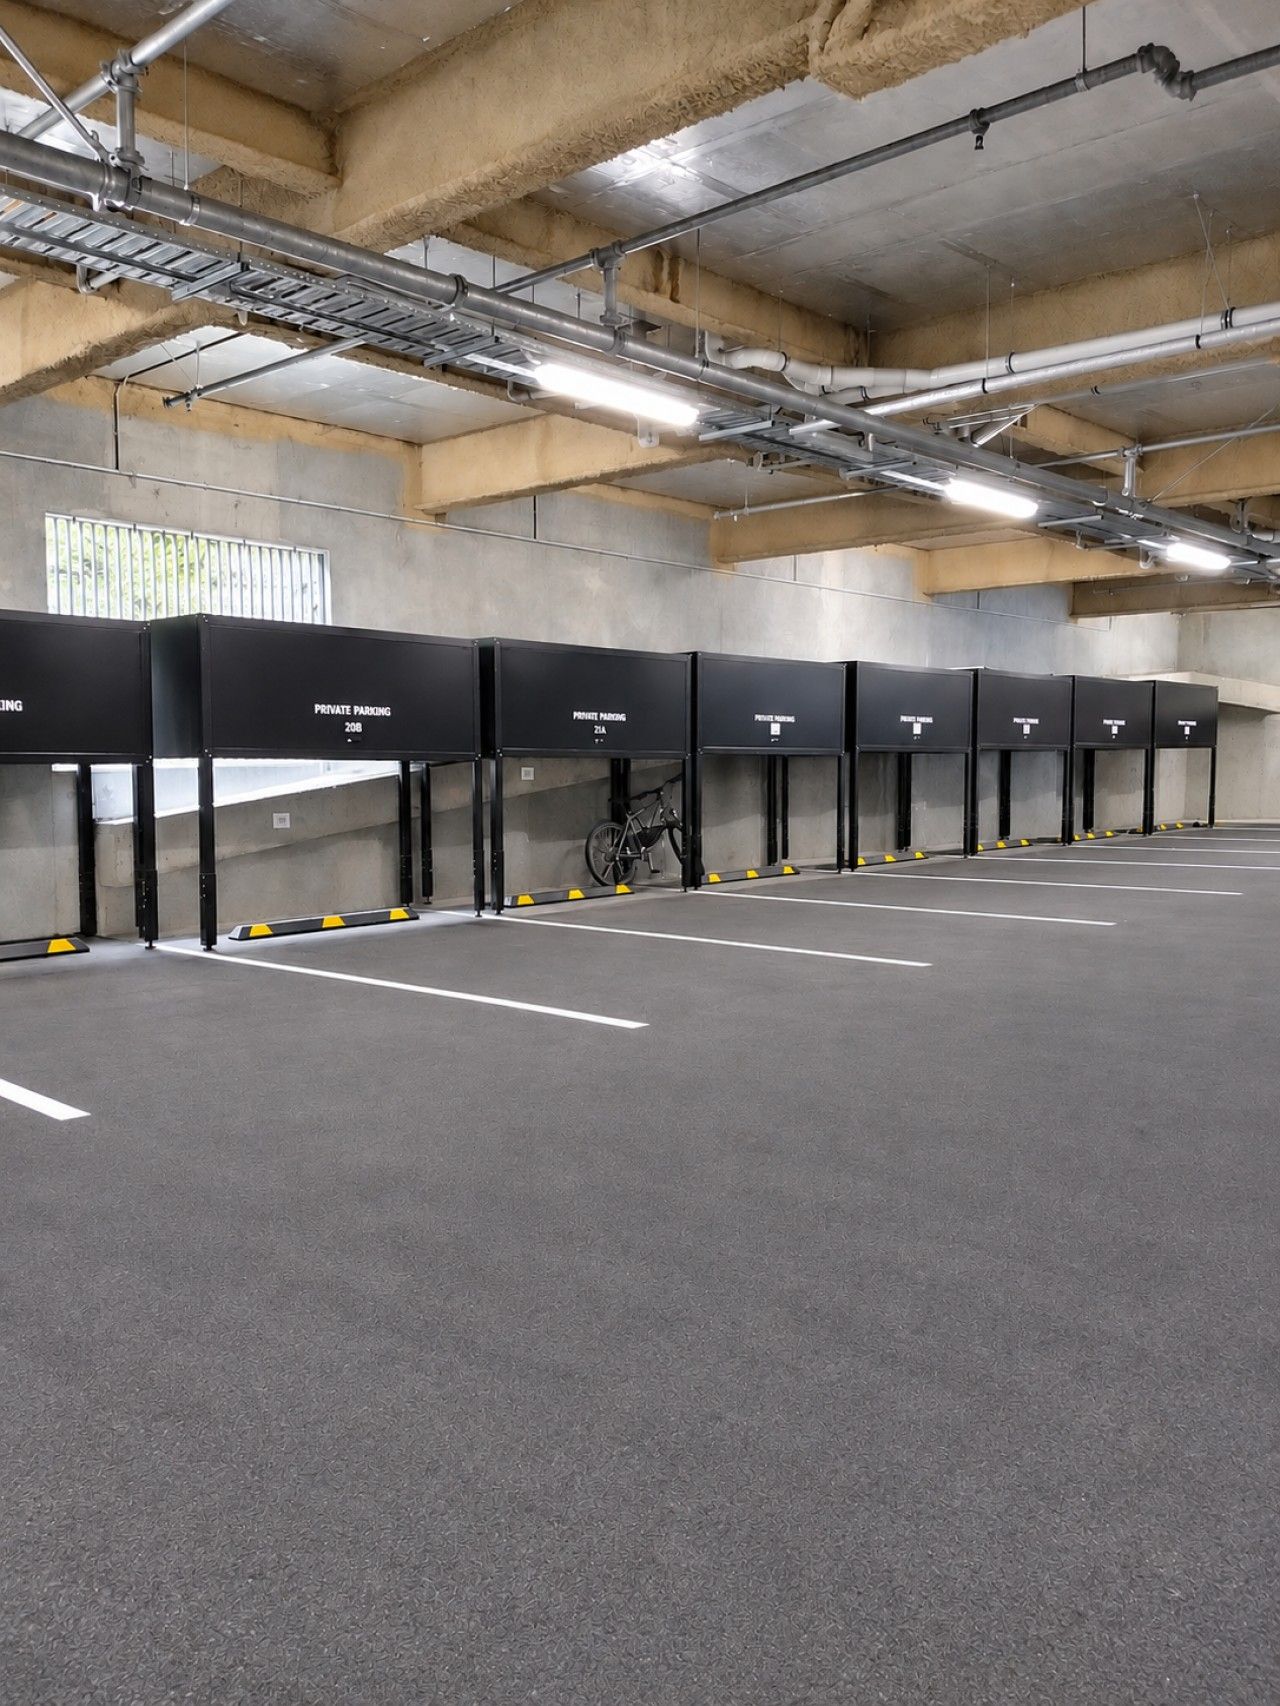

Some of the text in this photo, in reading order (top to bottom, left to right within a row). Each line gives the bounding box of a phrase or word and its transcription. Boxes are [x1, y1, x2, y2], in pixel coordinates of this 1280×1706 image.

[0, 699, 23, 711] ING
[314, 704, 391, 716] PRIVATE PARKING
